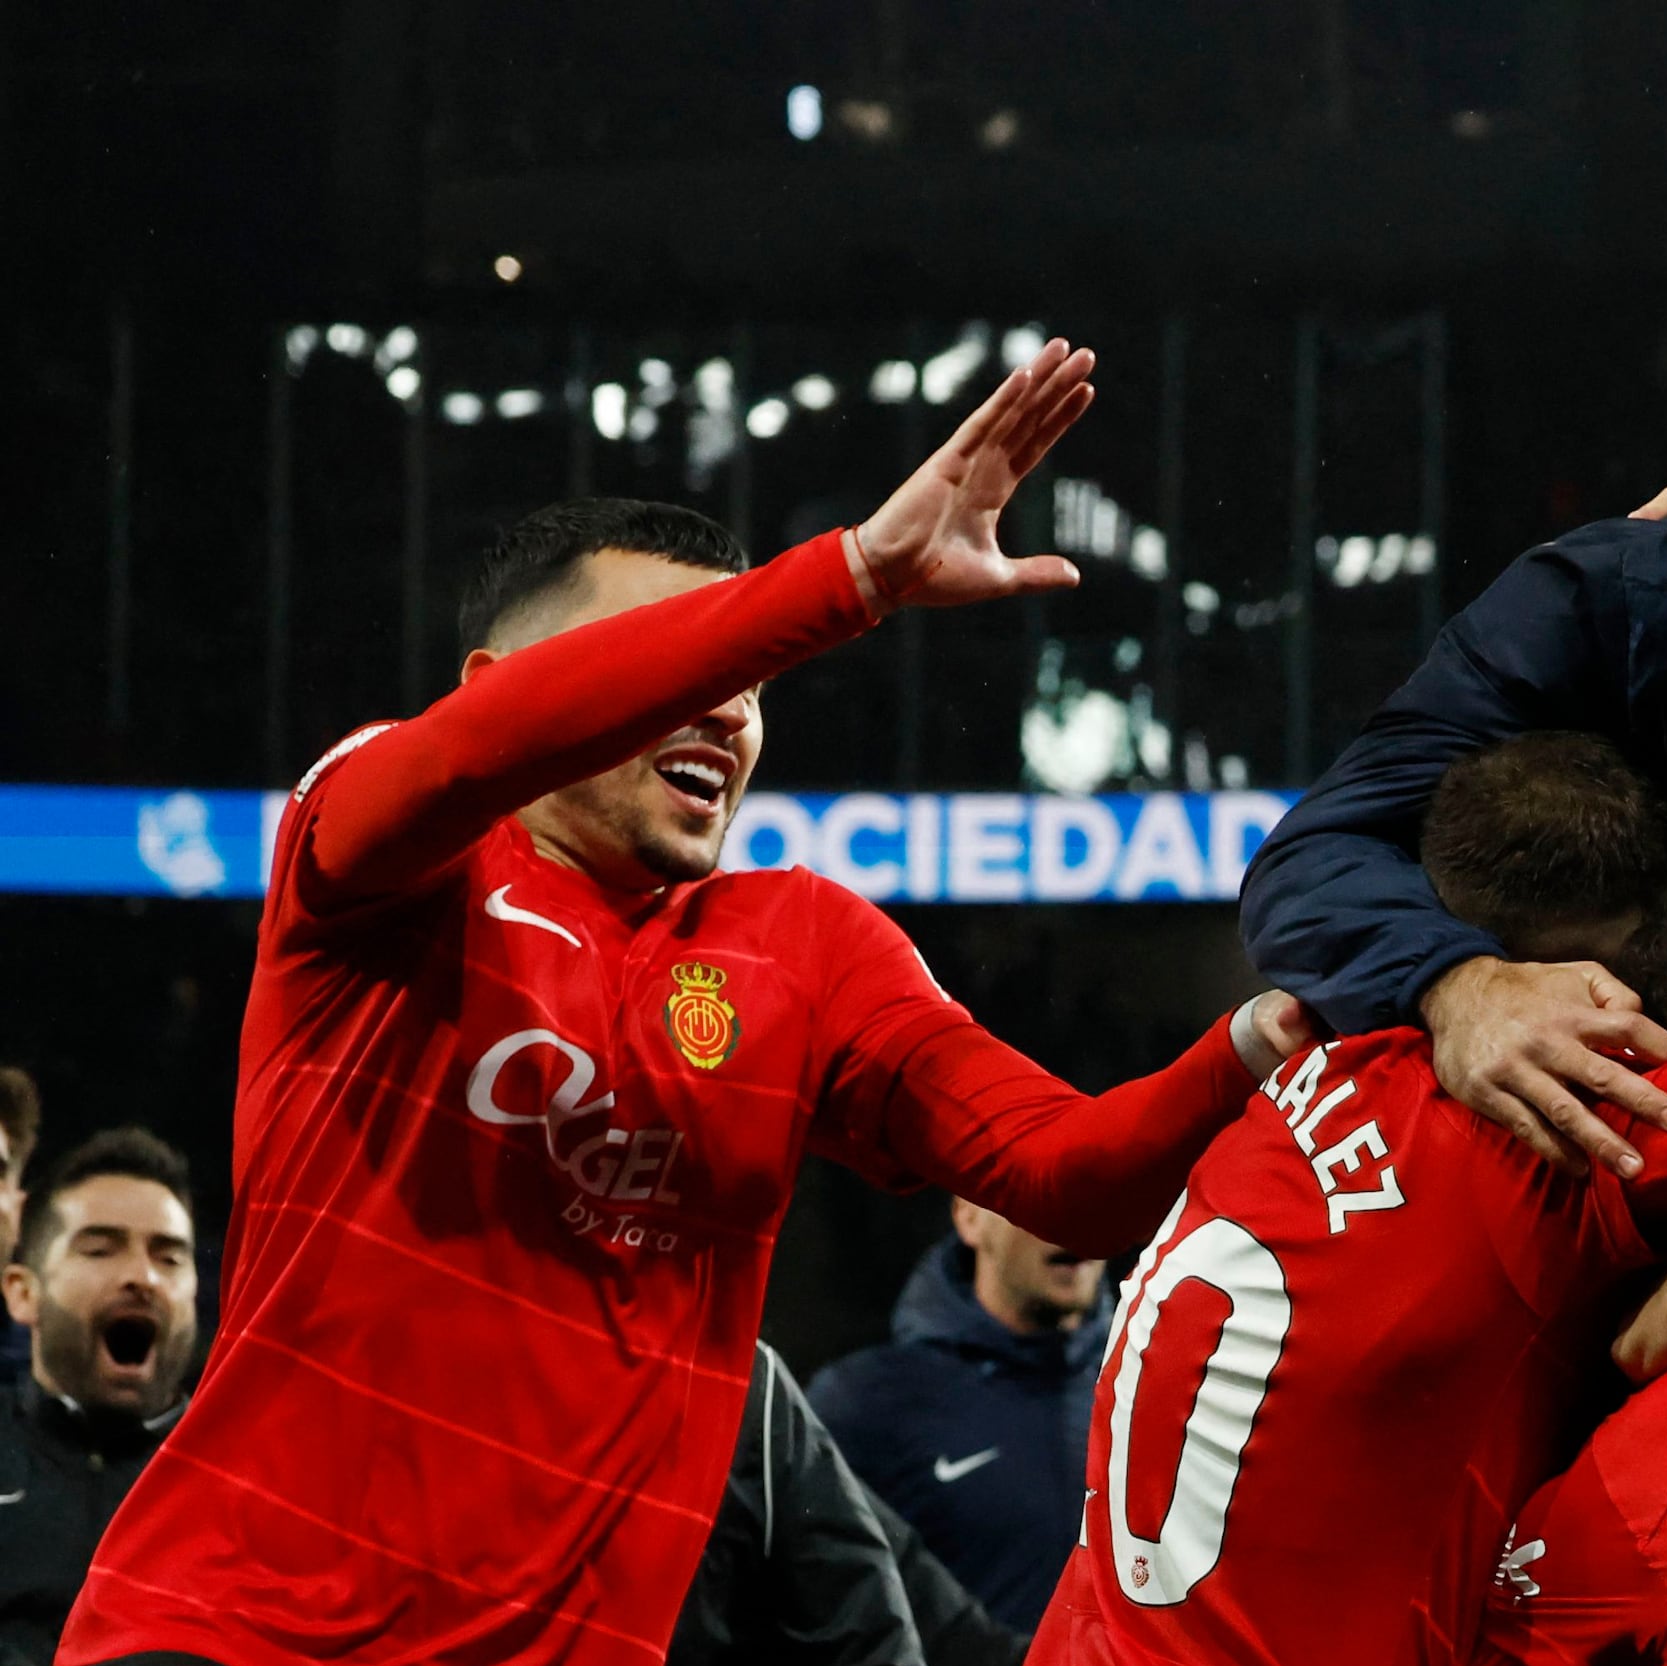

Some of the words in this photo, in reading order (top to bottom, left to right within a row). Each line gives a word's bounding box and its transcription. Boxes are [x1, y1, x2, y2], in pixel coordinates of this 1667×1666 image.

[719, 791, 1290, 900] OCIEDAD
[560, 1192, 605, 1237] by
[1079, 1187, 1292, 1606] 0
